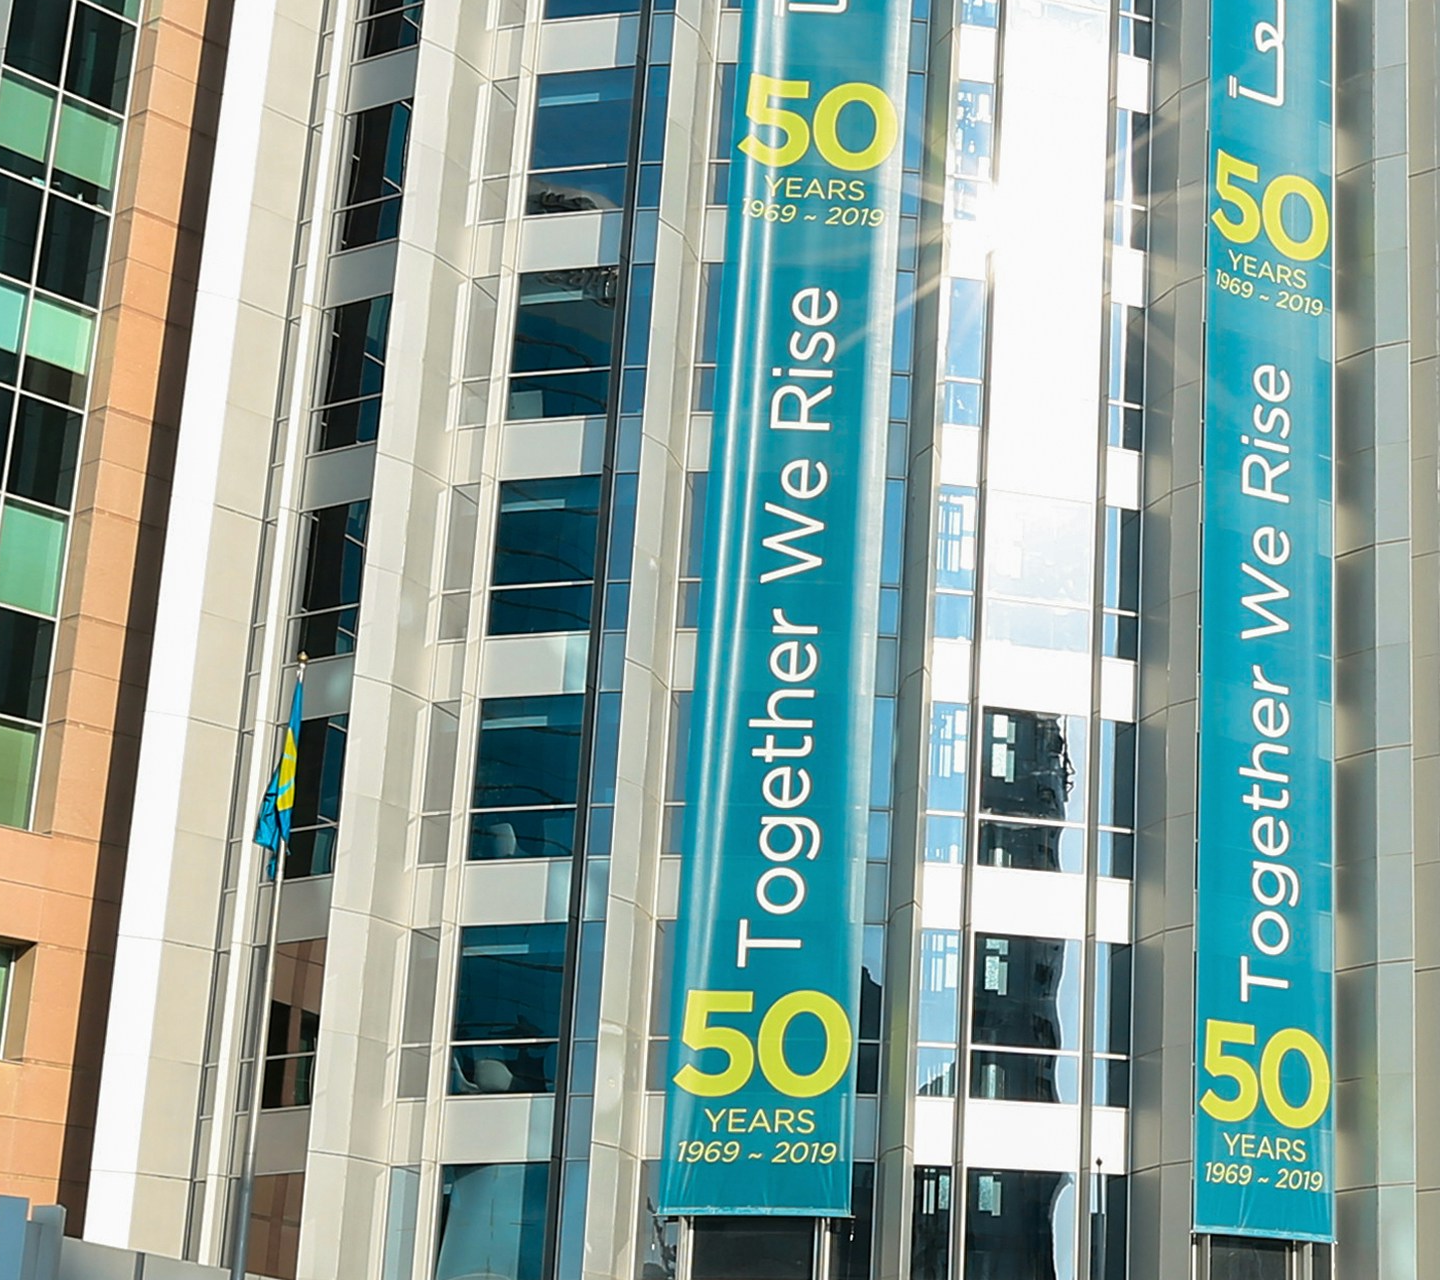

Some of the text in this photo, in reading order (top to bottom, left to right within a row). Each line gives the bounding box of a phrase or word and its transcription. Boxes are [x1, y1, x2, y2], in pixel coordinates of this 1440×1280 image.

[737, 72, 897, 172] 50
[764, 175, 866, 202] YEARS
[1211, 148, 1330, 262] 50
[742, 197, 797, 223] 1969
[824, 206, 885, 228] 2019
[1226, 249, 1308, 290] YEARS
[1214, 269, 1253, 299] 1969
[1276, 289, 1324, 317] 2019
[736, 286, 840, 969] Together We Rise
[1239, 363, 1301, 1003] Together We Rise
[673, 989, 853, 1098] 50
[1199, 1018, 1331, 1130] 50
[704, 1107, 816, 1135] YEARS
[676, 1139, 740, 1165] 1969
[770, 1140, 837, 1165] 2019
[1223, 1131, 1307, 1163] YEARS
[1204, 1161, 1252, 1187] 1969
[1274, 1166, 1324, 1192] 2019
